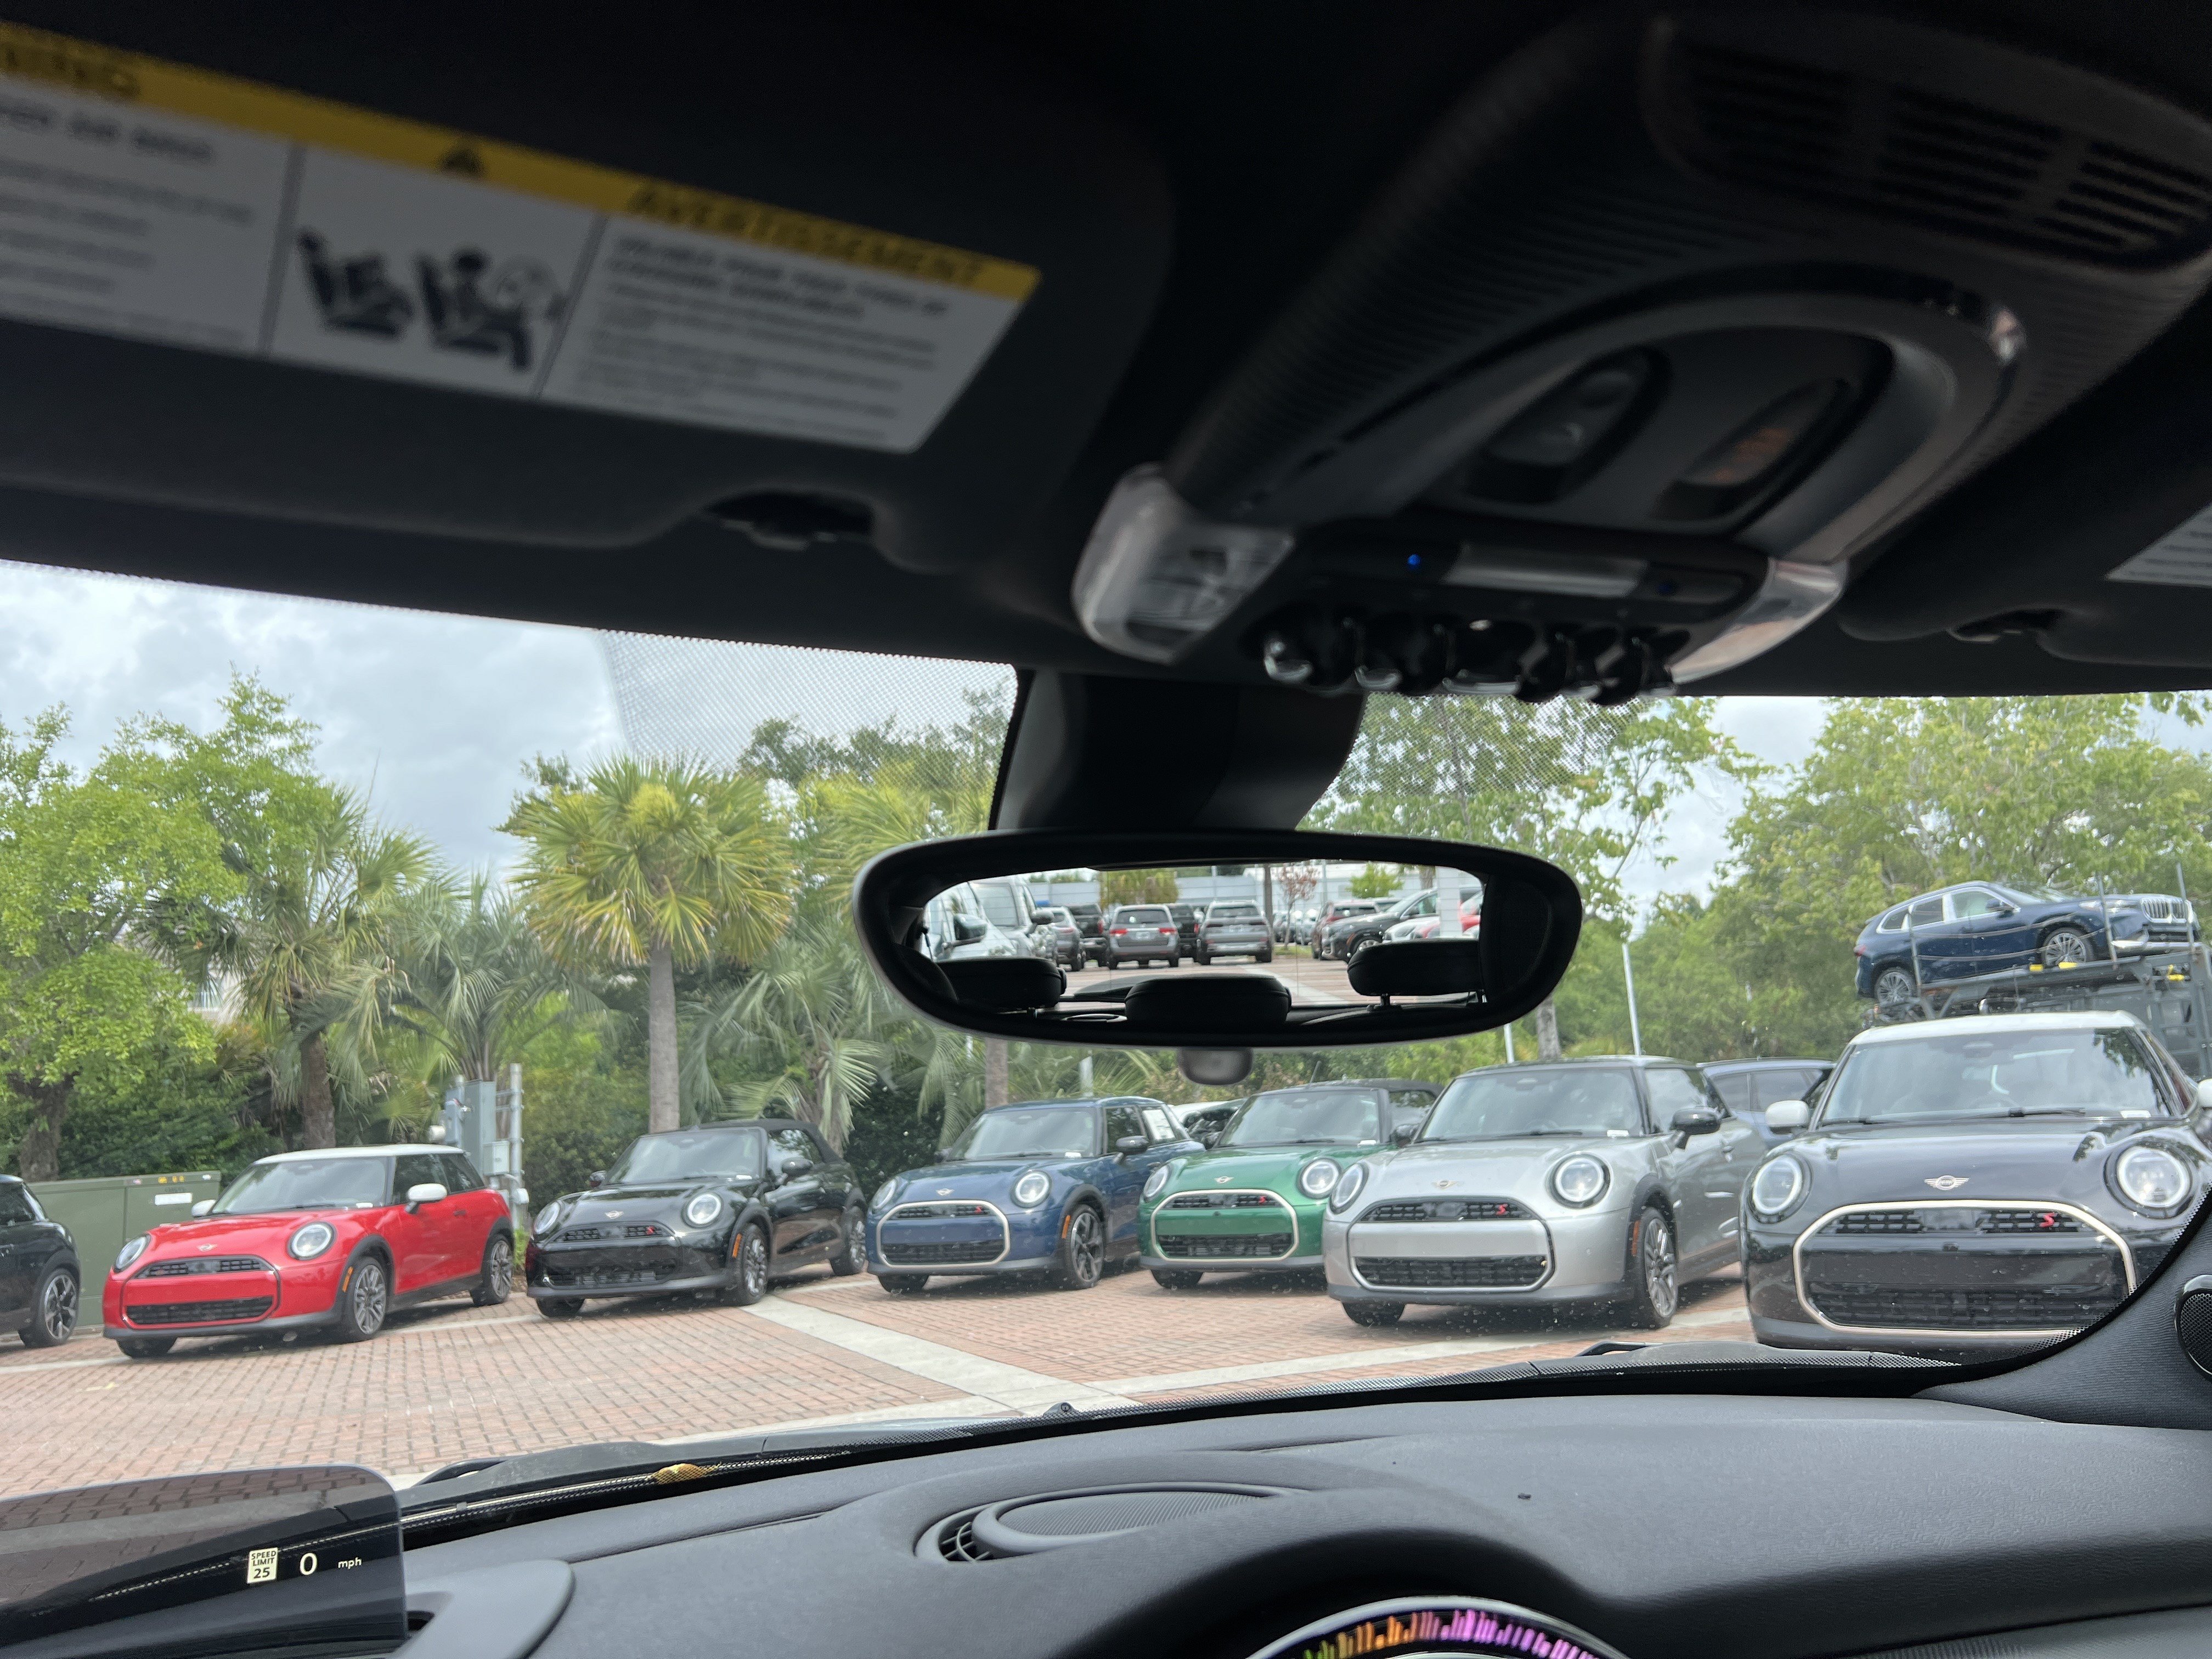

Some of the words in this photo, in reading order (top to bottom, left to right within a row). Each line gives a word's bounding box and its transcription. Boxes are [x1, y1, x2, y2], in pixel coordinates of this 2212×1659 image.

[251, 1550, 276, 1560] SPEED
[252, 1557, 274, 1566] LIMIT
[300, 1553, 317, 1575] 0
[338, 1557, 362, 1569] mph
[253, 1567, 270, 1579] 25
